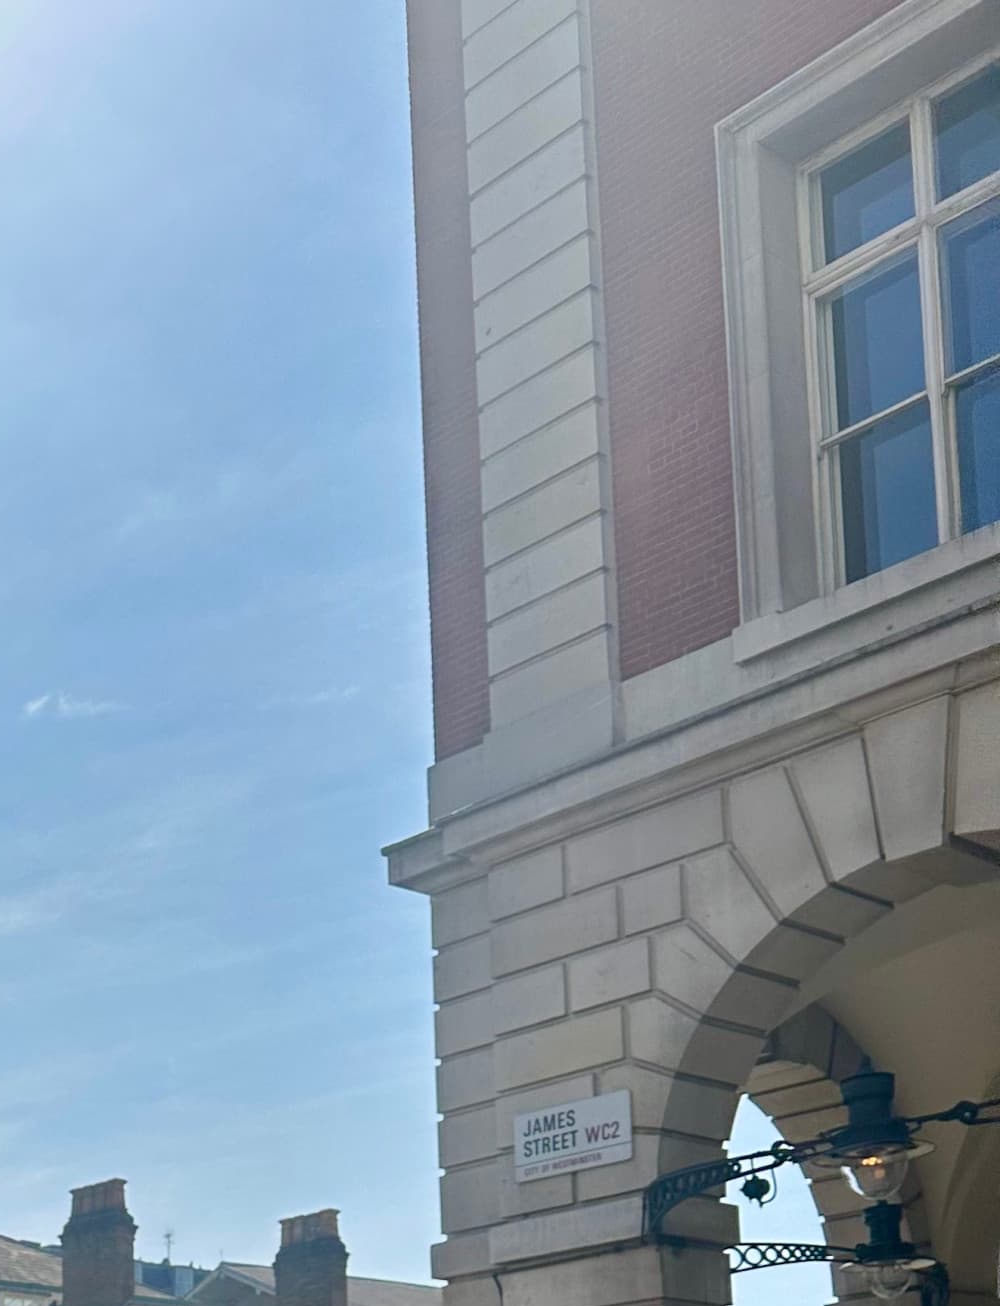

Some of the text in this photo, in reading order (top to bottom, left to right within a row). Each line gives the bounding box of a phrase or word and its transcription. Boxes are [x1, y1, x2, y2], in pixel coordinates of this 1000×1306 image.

[523, 1109, 576, 1137] JAMES
[523, 1121, 620, 1158] STREET WC2
